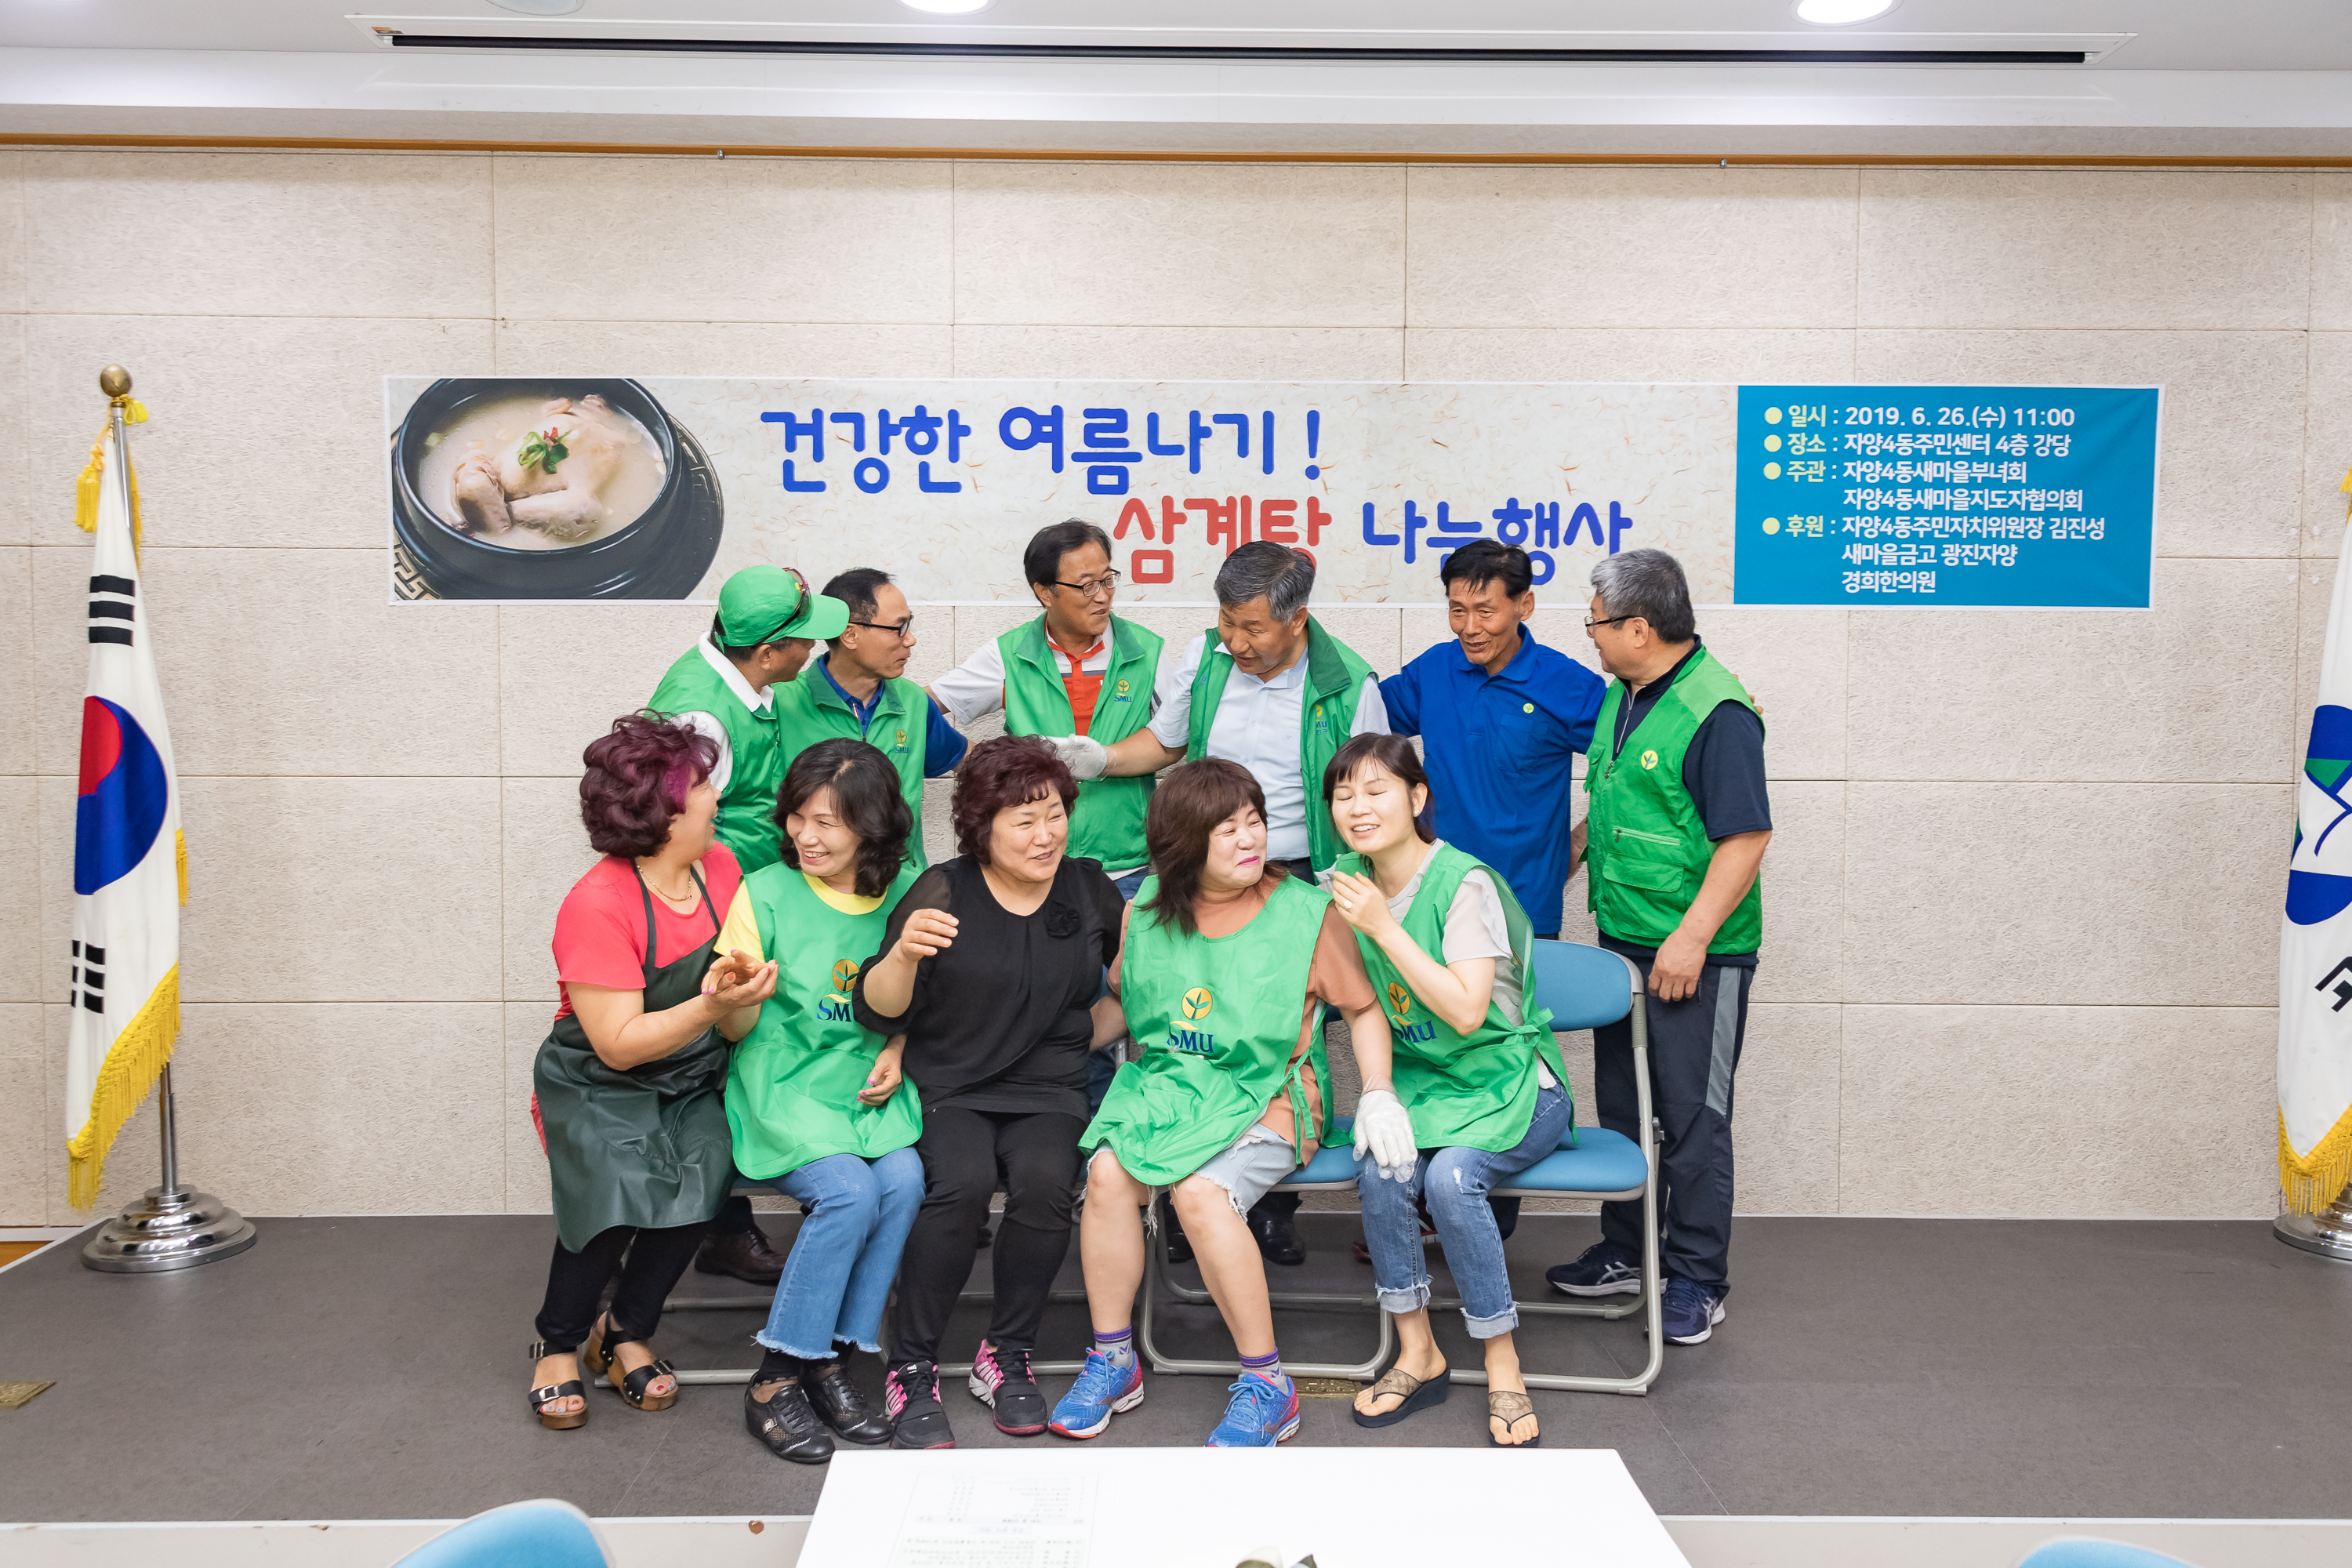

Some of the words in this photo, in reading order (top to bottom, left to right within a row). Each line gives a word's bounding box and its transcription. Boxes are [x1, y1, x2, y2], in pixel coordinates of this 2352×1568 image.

[1788, 405, 1826, 427] 일시
[2013, 408, 2075, 426] 11:00
[760, 405, 972, 494] 건강한
[1787, 432, 1827, 456] 장소
[1844, 432, 1991, 456] 자양4동주민센터
[1994, 433, 2029, 456] 4층
[2033, 434, 2072, 457] 강당
[1786, 459, 1826, 482] 주관
[1842, 460, 2027, 484] 자양4동새마을부녀회
[1843, 488, 2083, 512] 자양4동새마을지도자협의회
[1113, 495, 1332, 584] 삼계탕
[1785, 514, 1824, 537] 후원
[1842, 515, 2045, 539] 자양4동주민자치위원장
[2049, 517, 2105, 540] 김진성
[1842, 543, 1937, 566] 새마을금고
[1941, 543, 2018, 567] 광진자양
[1842, 570, 1936, 593] 경희한의원
[1114, 693, 1132, 702] SMU
[895, 744, 909, 753] SMU
[816, 994, 852, 1022] SM
[1166, 1021, 1214, 1053] SMU
